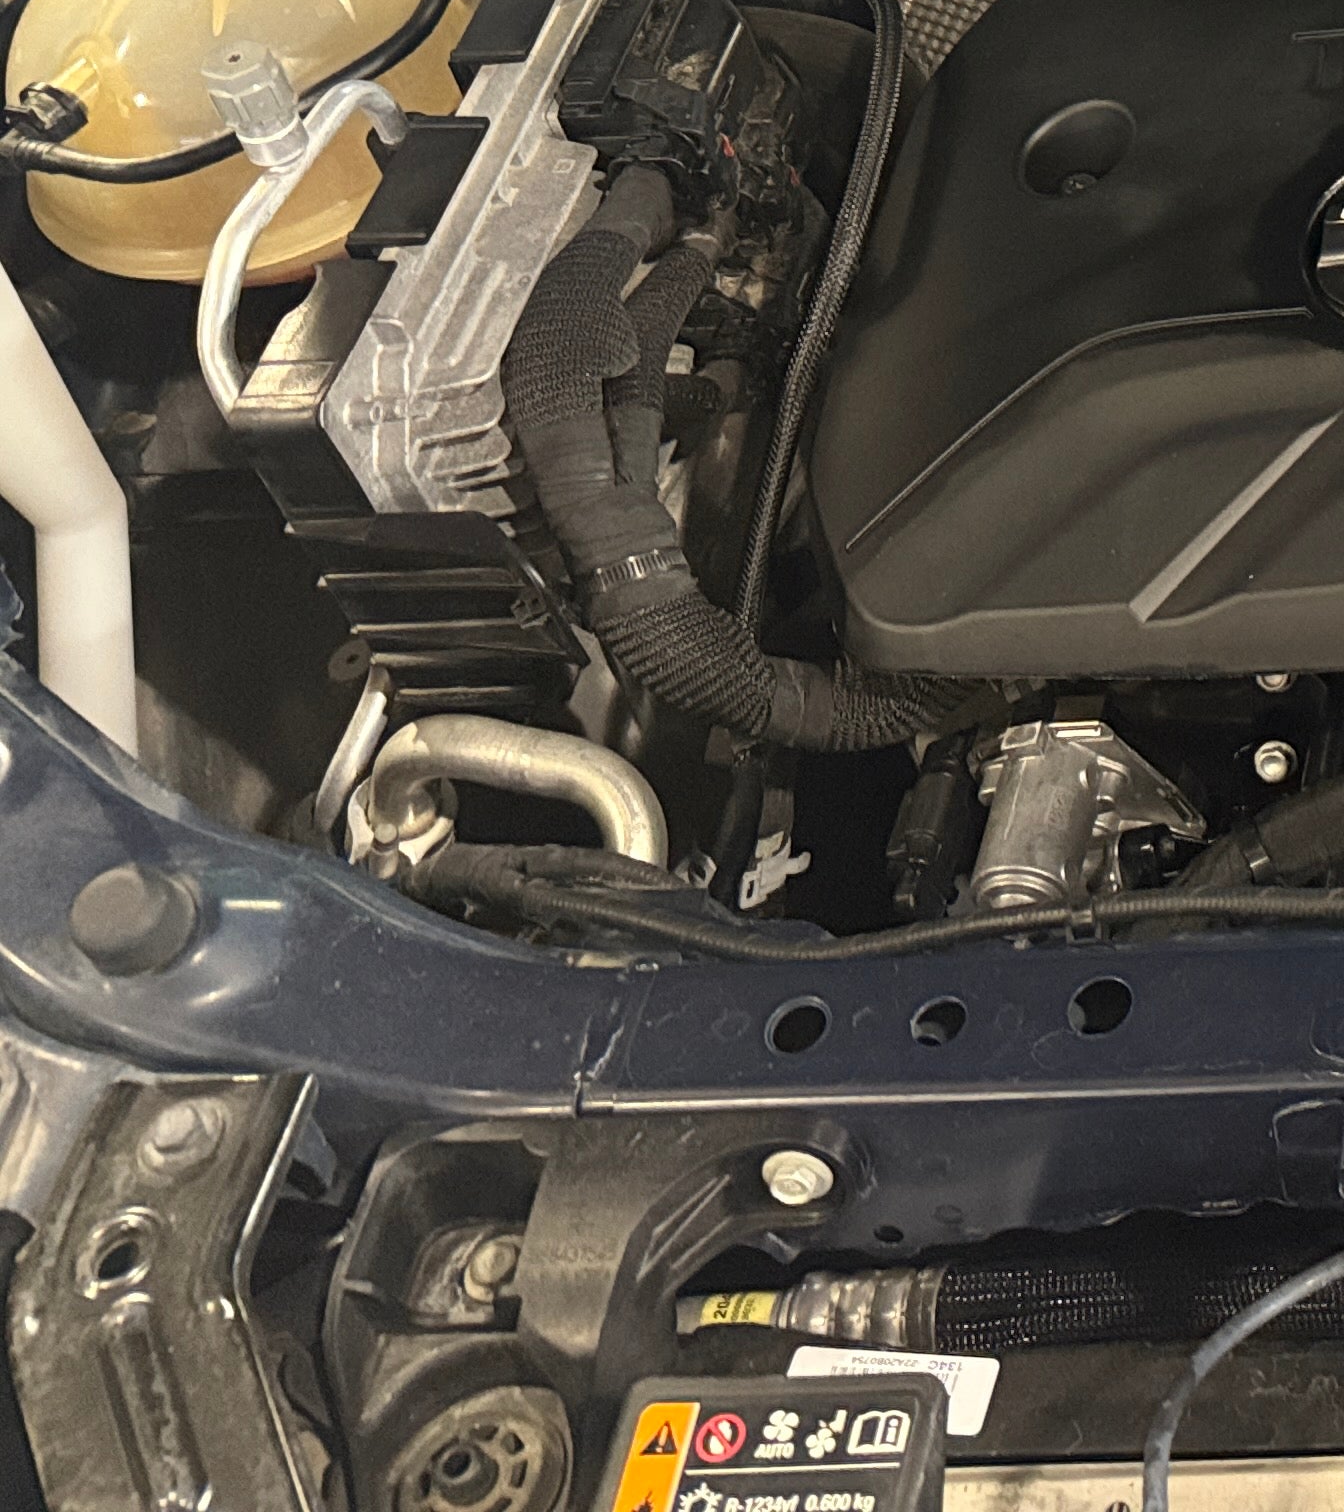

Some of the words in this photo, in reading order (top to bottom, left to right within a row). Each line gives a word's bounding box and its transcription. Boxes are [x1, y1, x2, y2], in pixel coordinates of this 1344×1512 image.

[753, 1442, 795, 1460] AUTO
[804, 1493, 851, 1512] 0.600
[852, 1492, 876, 1512] kg
